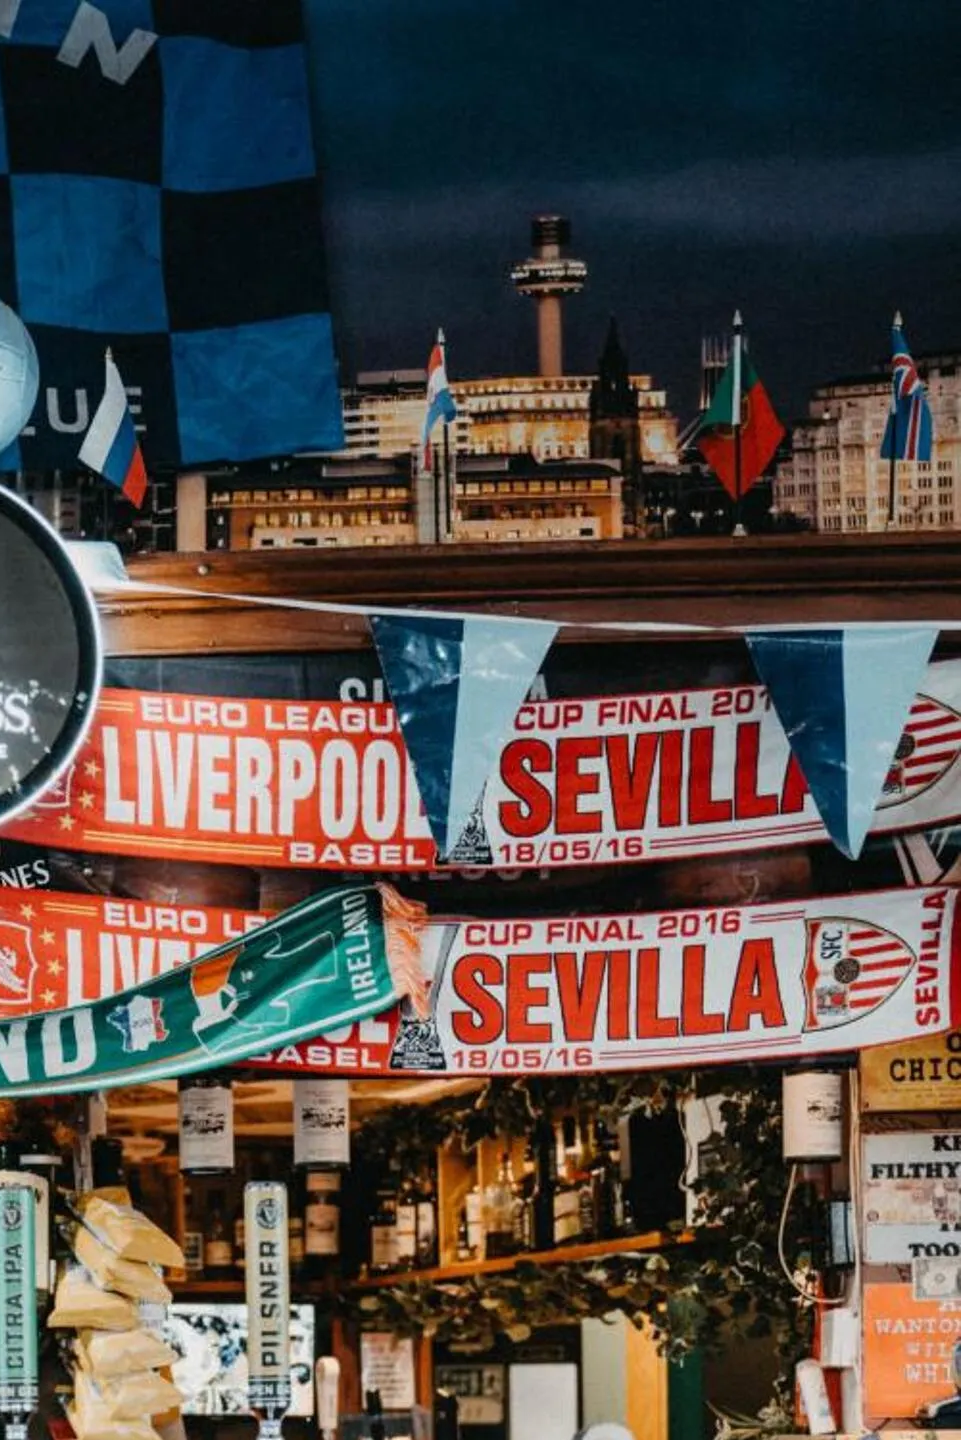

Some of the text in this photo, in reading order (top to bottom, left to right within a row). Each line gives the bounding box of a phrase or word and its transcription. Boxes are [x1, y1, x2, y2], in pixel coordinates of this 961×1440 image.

[140, 697, 402, 734] EURO LEAGU
[514, 687, 773, 732] CUP FINAL 201
[102, 727, 434, 842] LIVERPOOL
[290, 842, 426, 866] BASEL
[499, 837, 644, 864] 18/05/16
[103, 902, 208, 935] EURO
[465, 911, 741, 947] CUP FINAL 2016
[343, 892, 378, 1001] IRELAND
[821, 929, 843, 960] SFC
[914, 889, 948, 1027] SEVILLA
[451, 938, 788, 1045] SEVILLA
[452, 1048, 593, 1070] 18/05/16
[5, 1242, 23, 1285] IPA
[259, 1241, 281, 1368] PILSNER
[5, 1293, 24, 1370] CITRA
